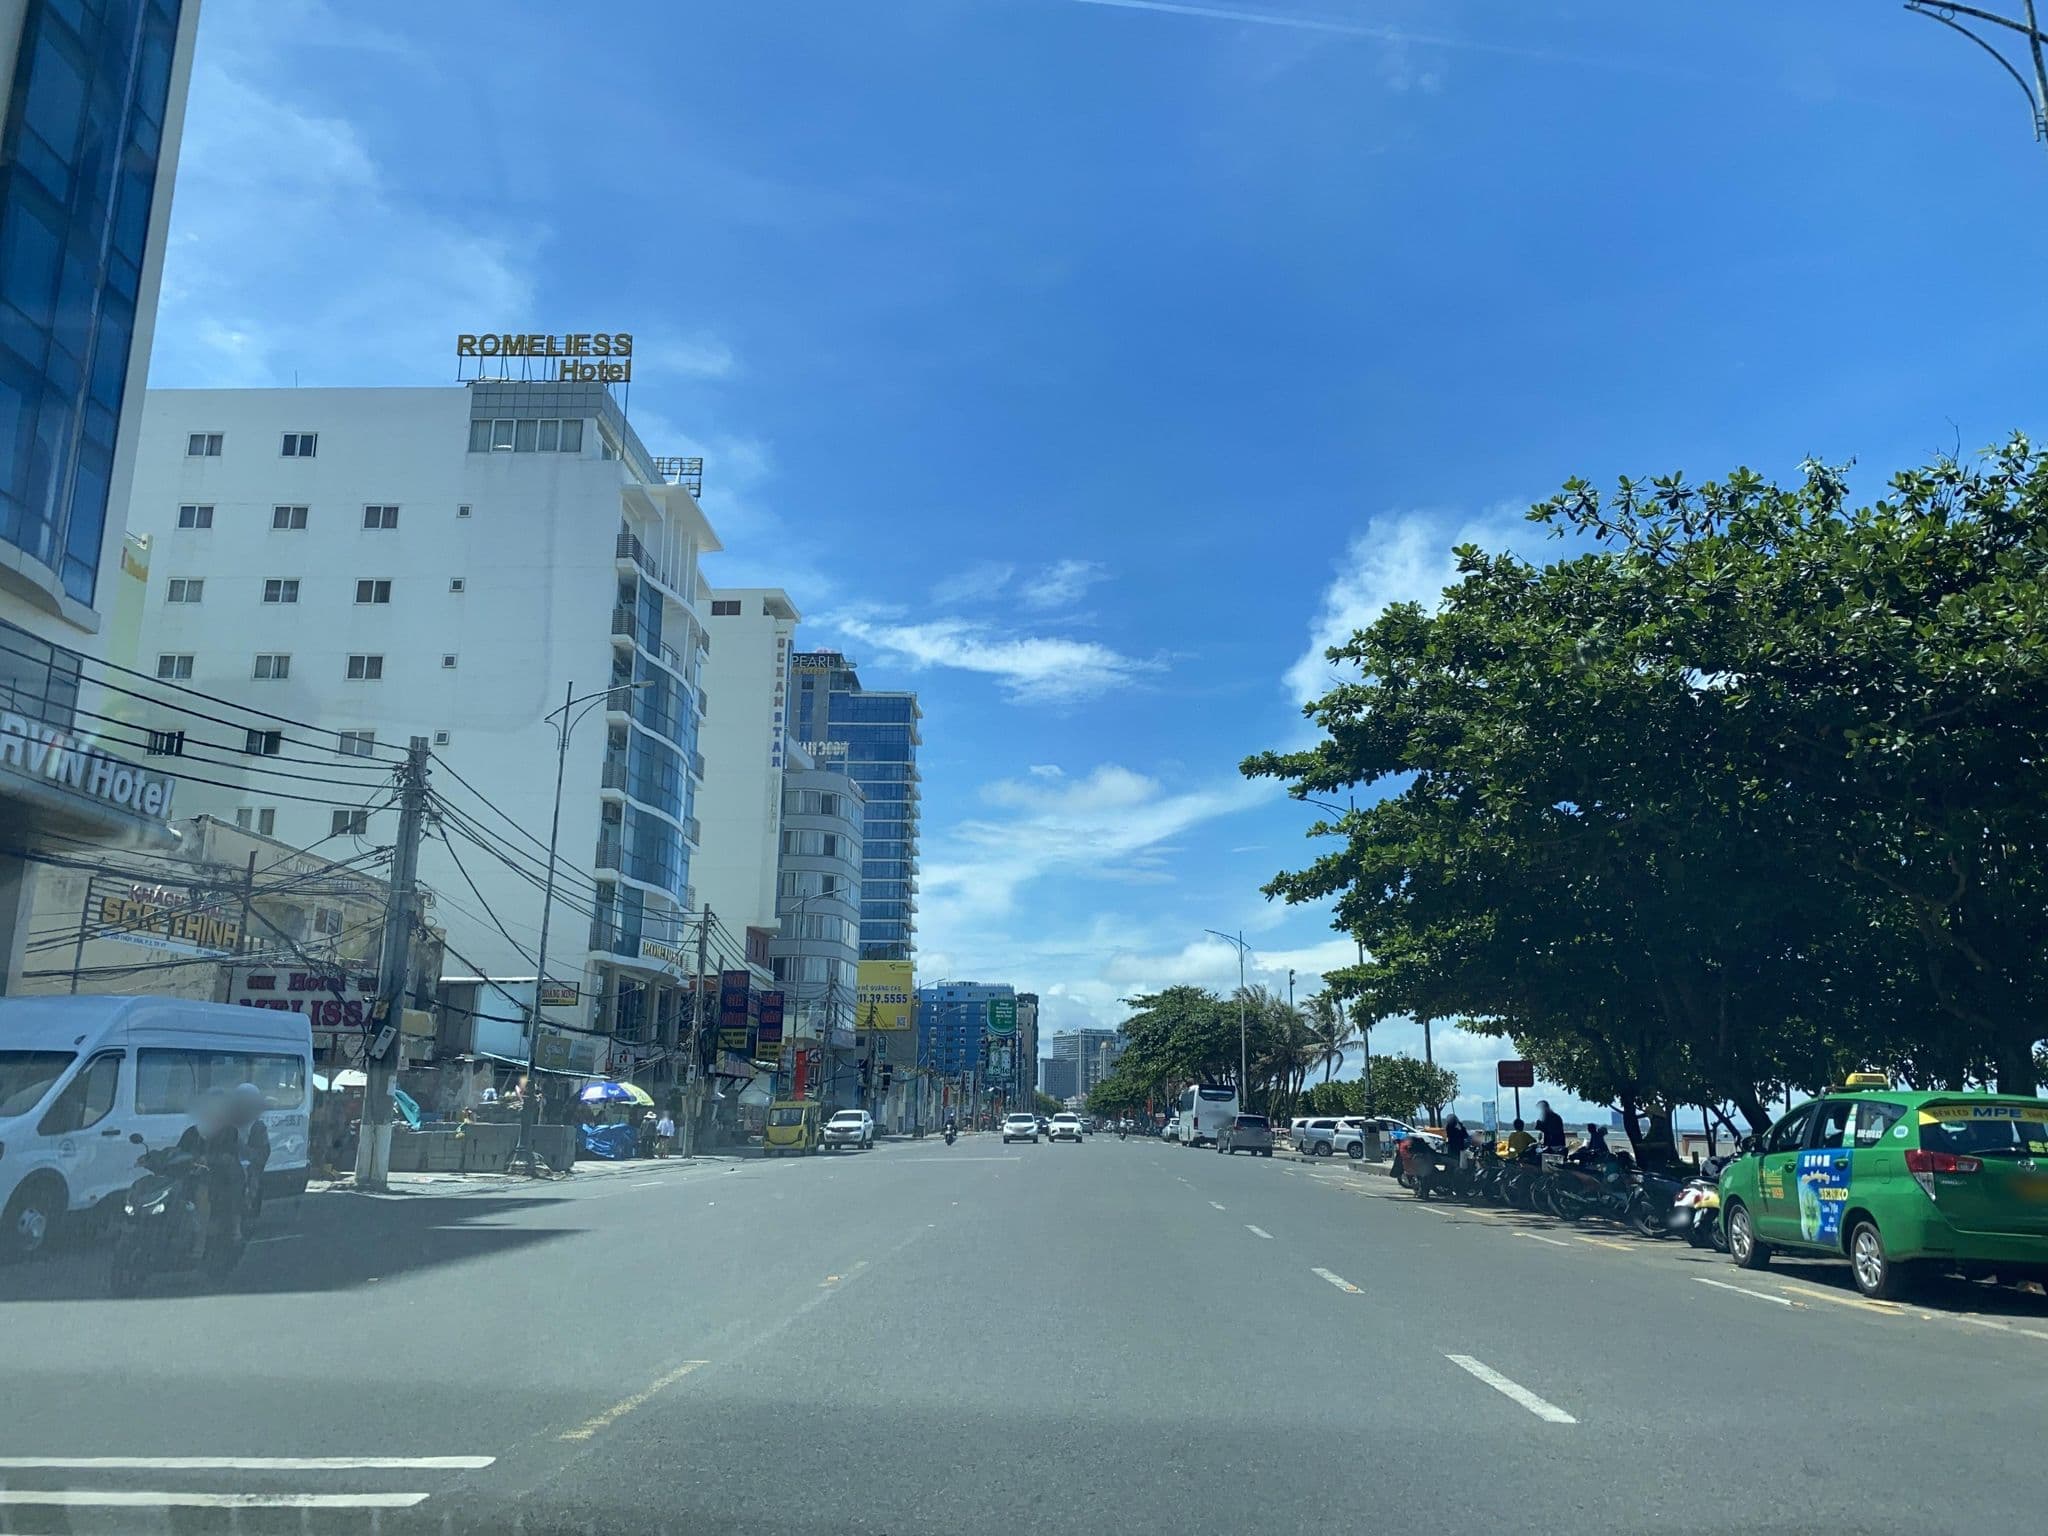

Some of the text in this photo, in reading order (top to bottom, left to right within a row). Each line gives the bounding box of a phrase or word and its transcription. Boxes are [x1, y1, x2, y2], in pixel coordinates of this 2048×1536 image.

[457, 334, 632, 356] ROMELIESS
[560, 360, 631, 382] Hotel
[792, 656, 831, 668] PEARL
[87, 751, 175, 819] Hotel
[1973, 1107, 2022, 1118] MPE
